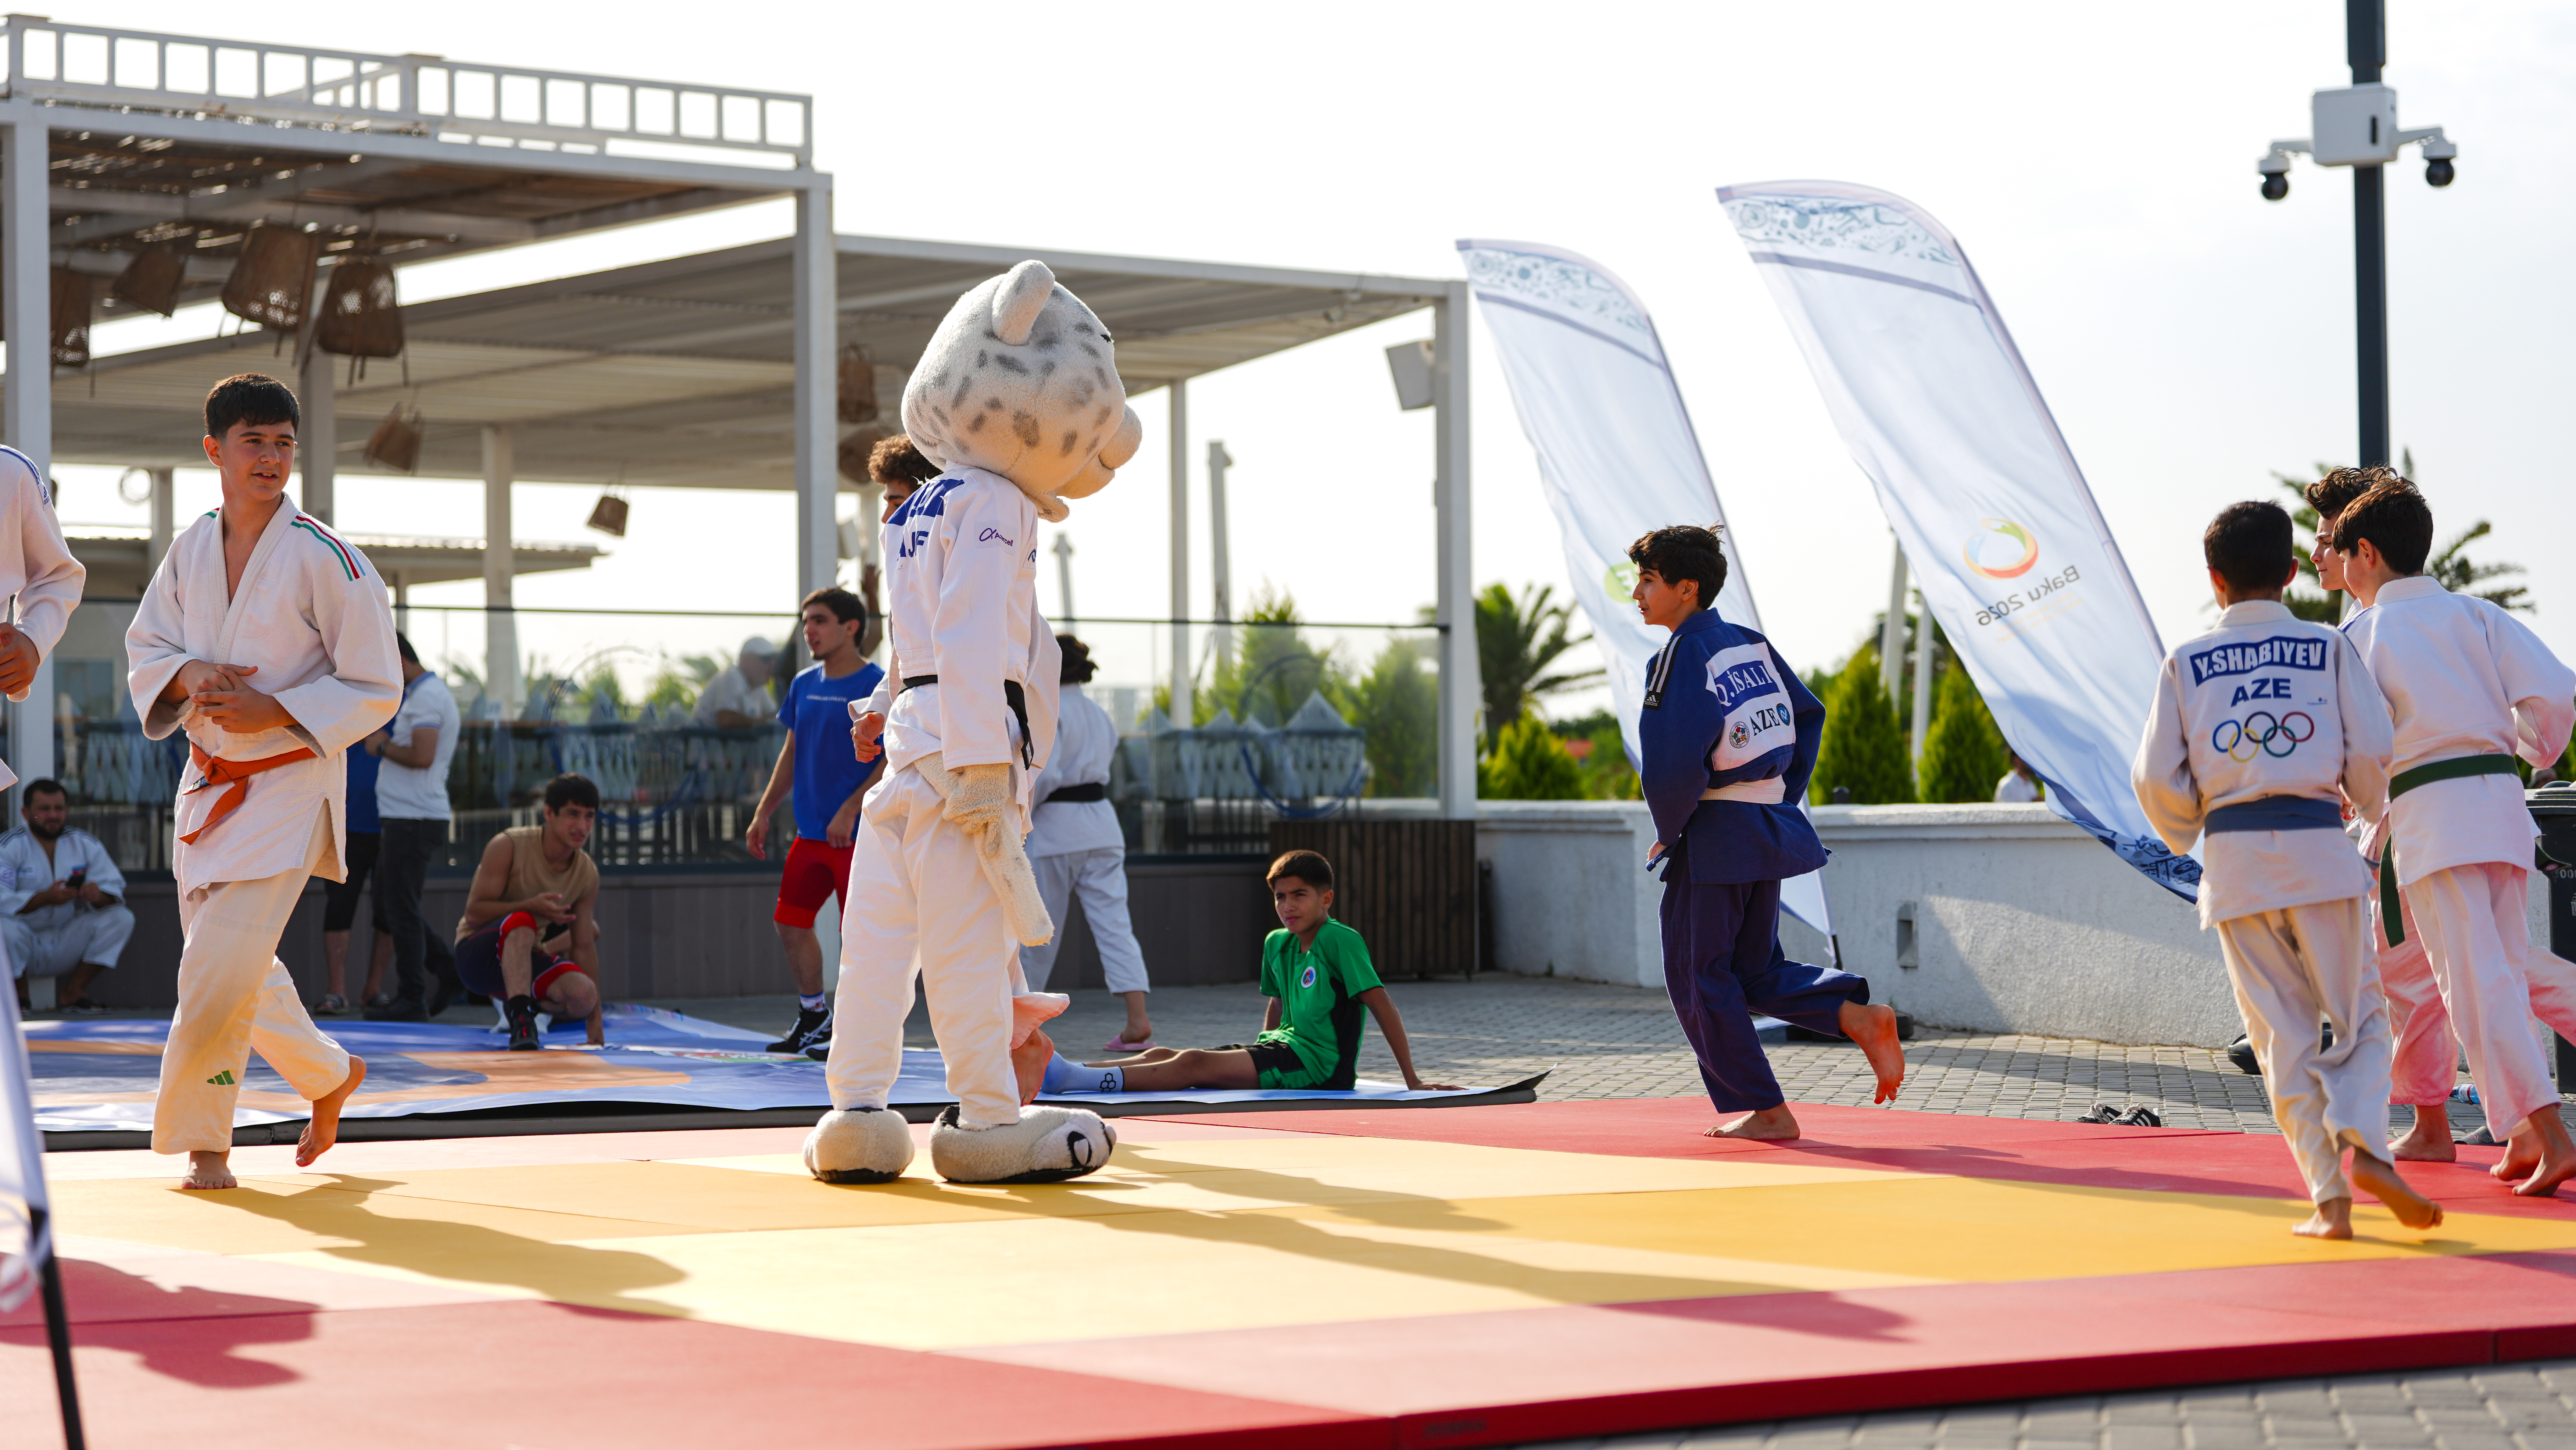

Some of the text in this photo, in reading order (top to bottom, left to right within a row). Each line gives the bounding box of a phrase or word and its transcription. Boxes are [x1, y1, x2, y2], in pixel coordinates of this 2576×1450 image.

[2194, 640, 2323, 680] Y.SHABIYEV
[2230, 678, 2291, 708] AZE
[1749, 708, 1781, 736] AZE
